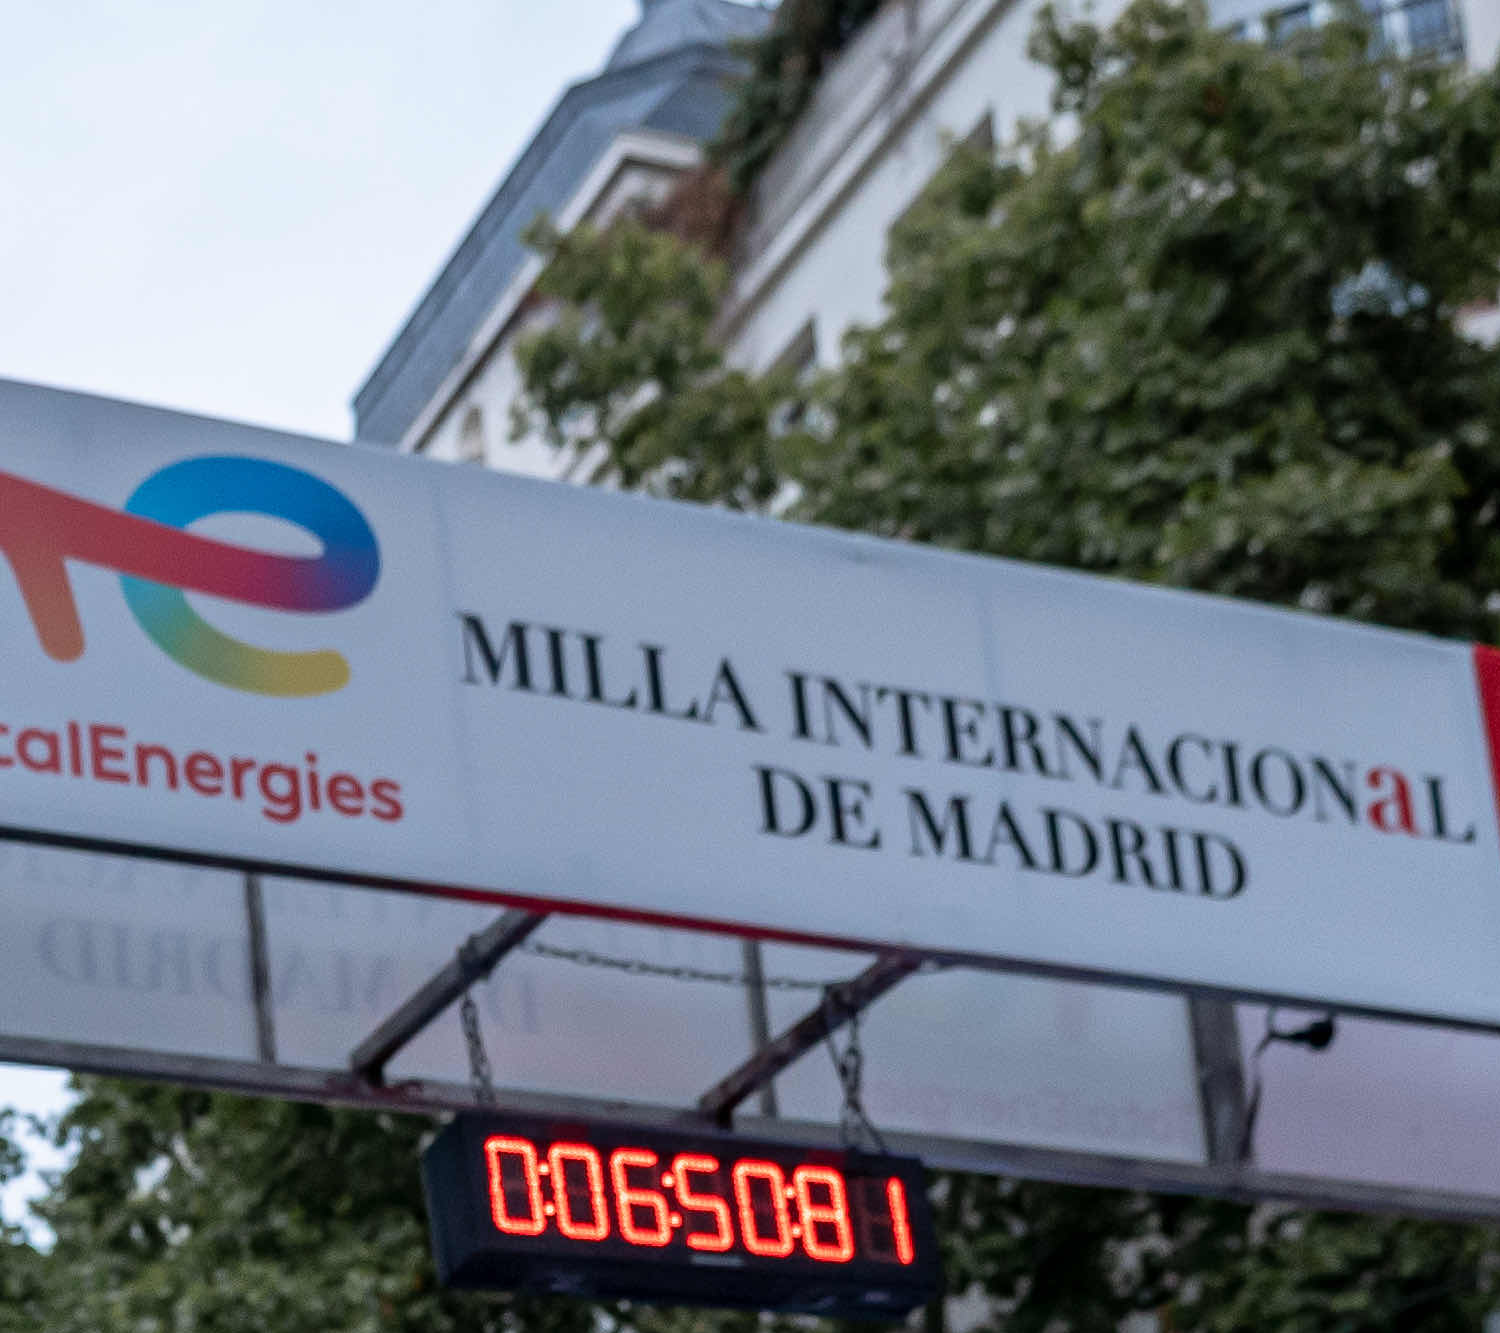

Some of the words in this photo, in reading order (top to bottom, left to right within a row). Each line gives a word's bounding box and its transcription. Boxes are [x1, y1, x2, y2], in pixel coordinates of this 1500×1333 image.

[456, 611, 764, 734] MILLA
[750, 763, 884, 854] DE
[905, 788, 1250, 903] MADRID
